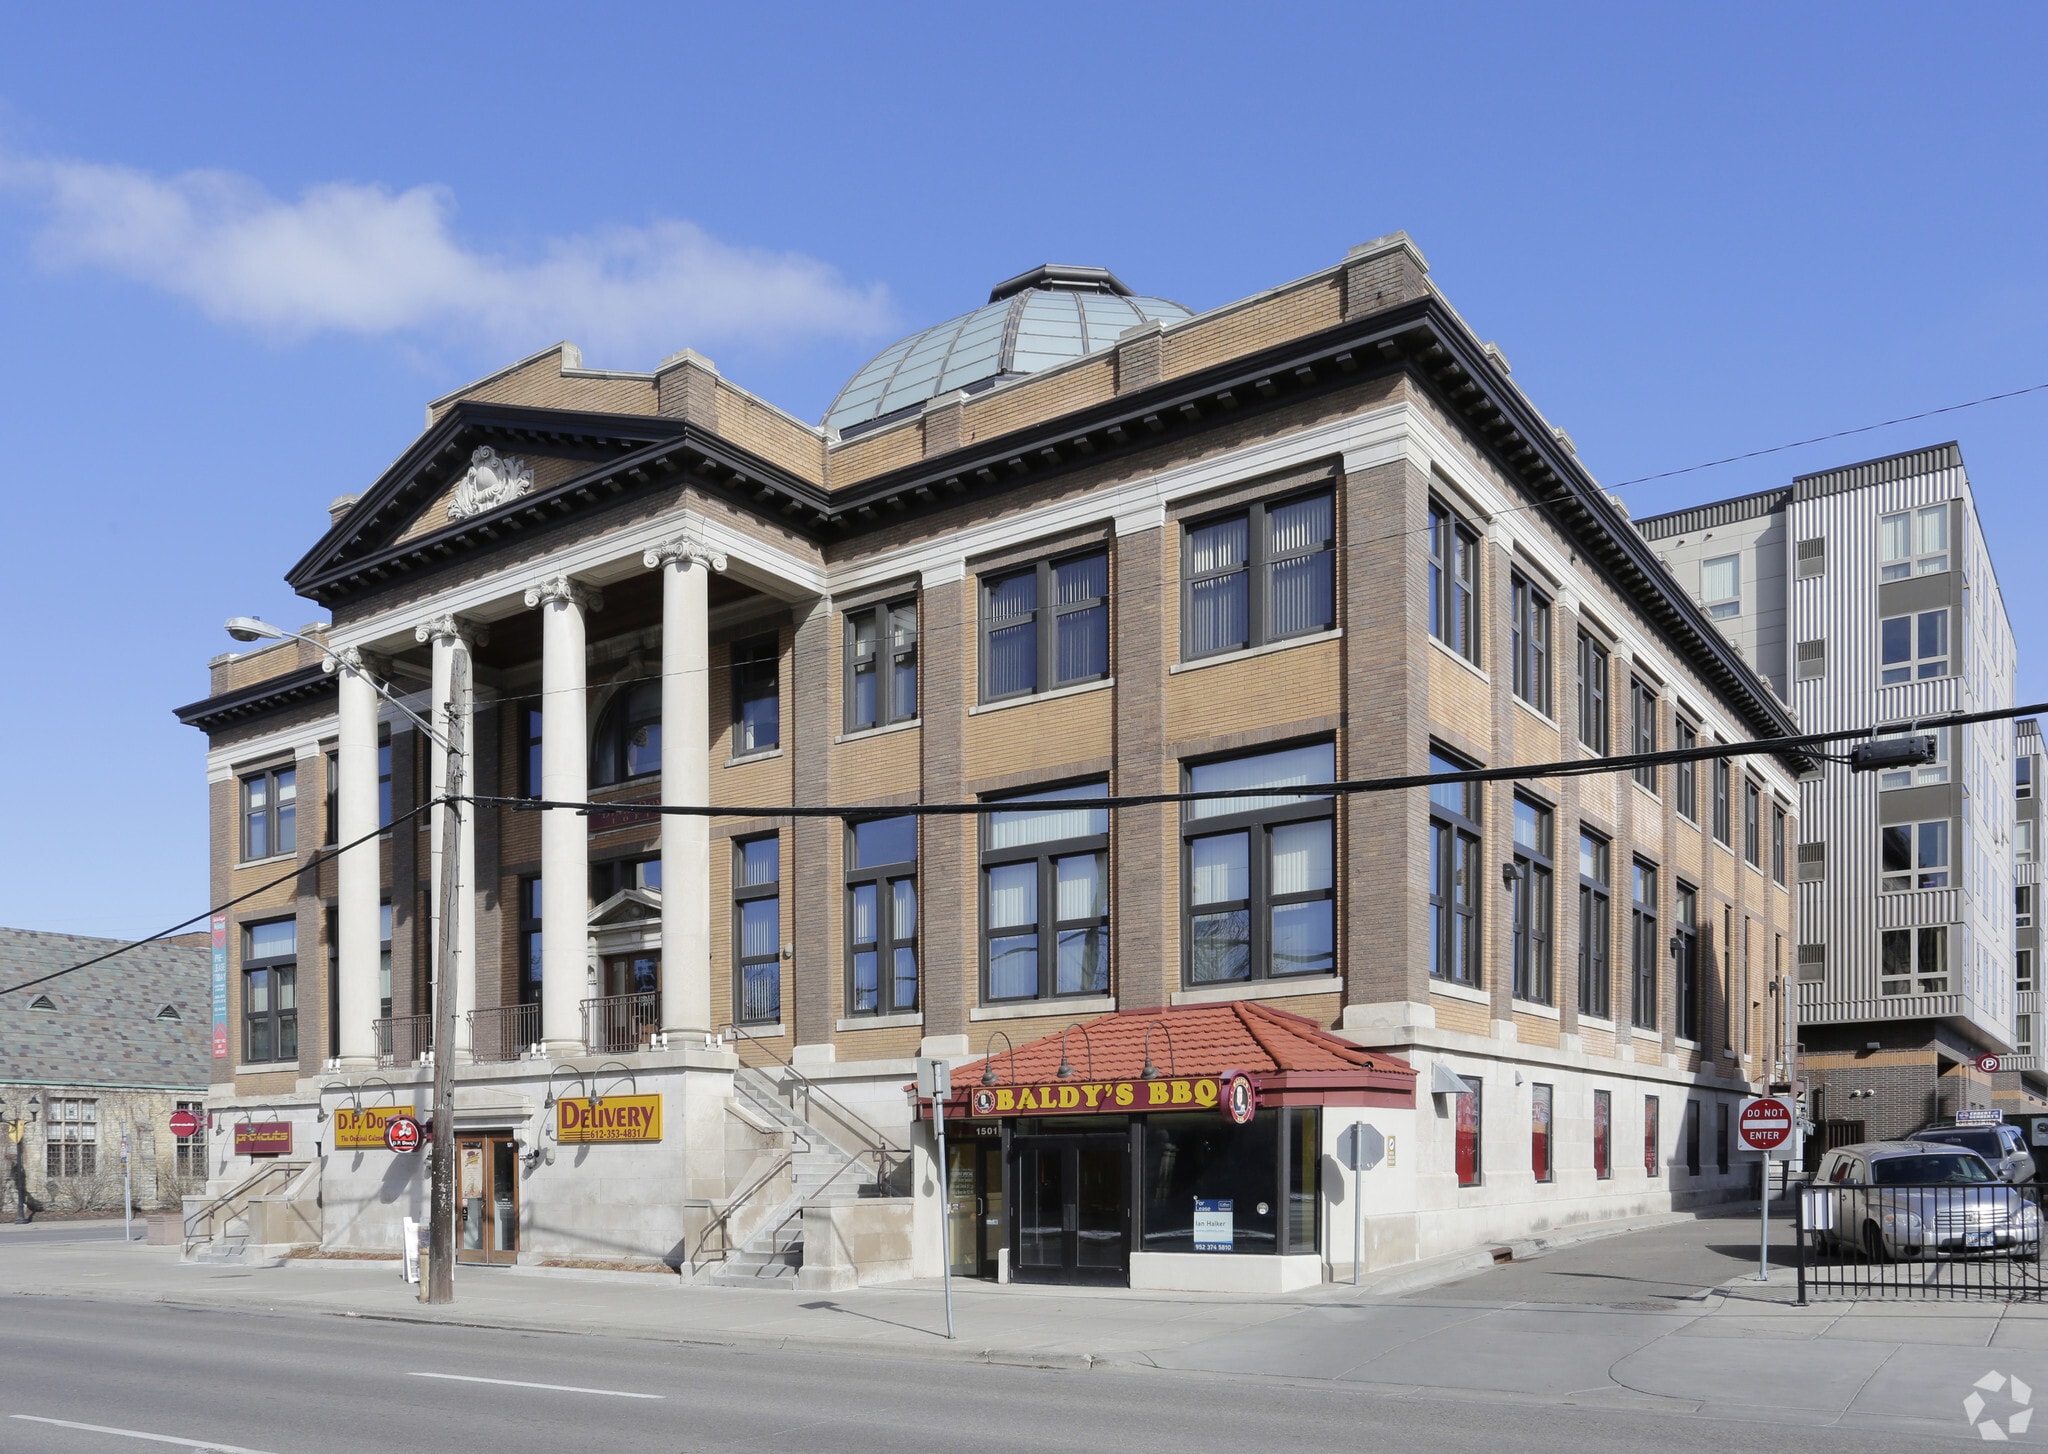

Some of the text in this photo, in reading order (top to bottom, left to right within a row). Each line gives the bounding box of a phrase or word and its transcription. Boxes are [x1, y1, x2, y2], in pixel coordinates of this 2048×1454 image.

[996, 1083, 1134, 1111] BALDY'S
[1148, 1078, 1218, 1108] BBQ
[1747, 1108, 1785, 1118] DO NOT
[338, 1113, 361, 1130] D.P.
[590, 1129, 641, 1139] 612-353-4831
[975, 1127, 998, 1136] 1501
[1750, 1131, 1780, 1140] ENTER
